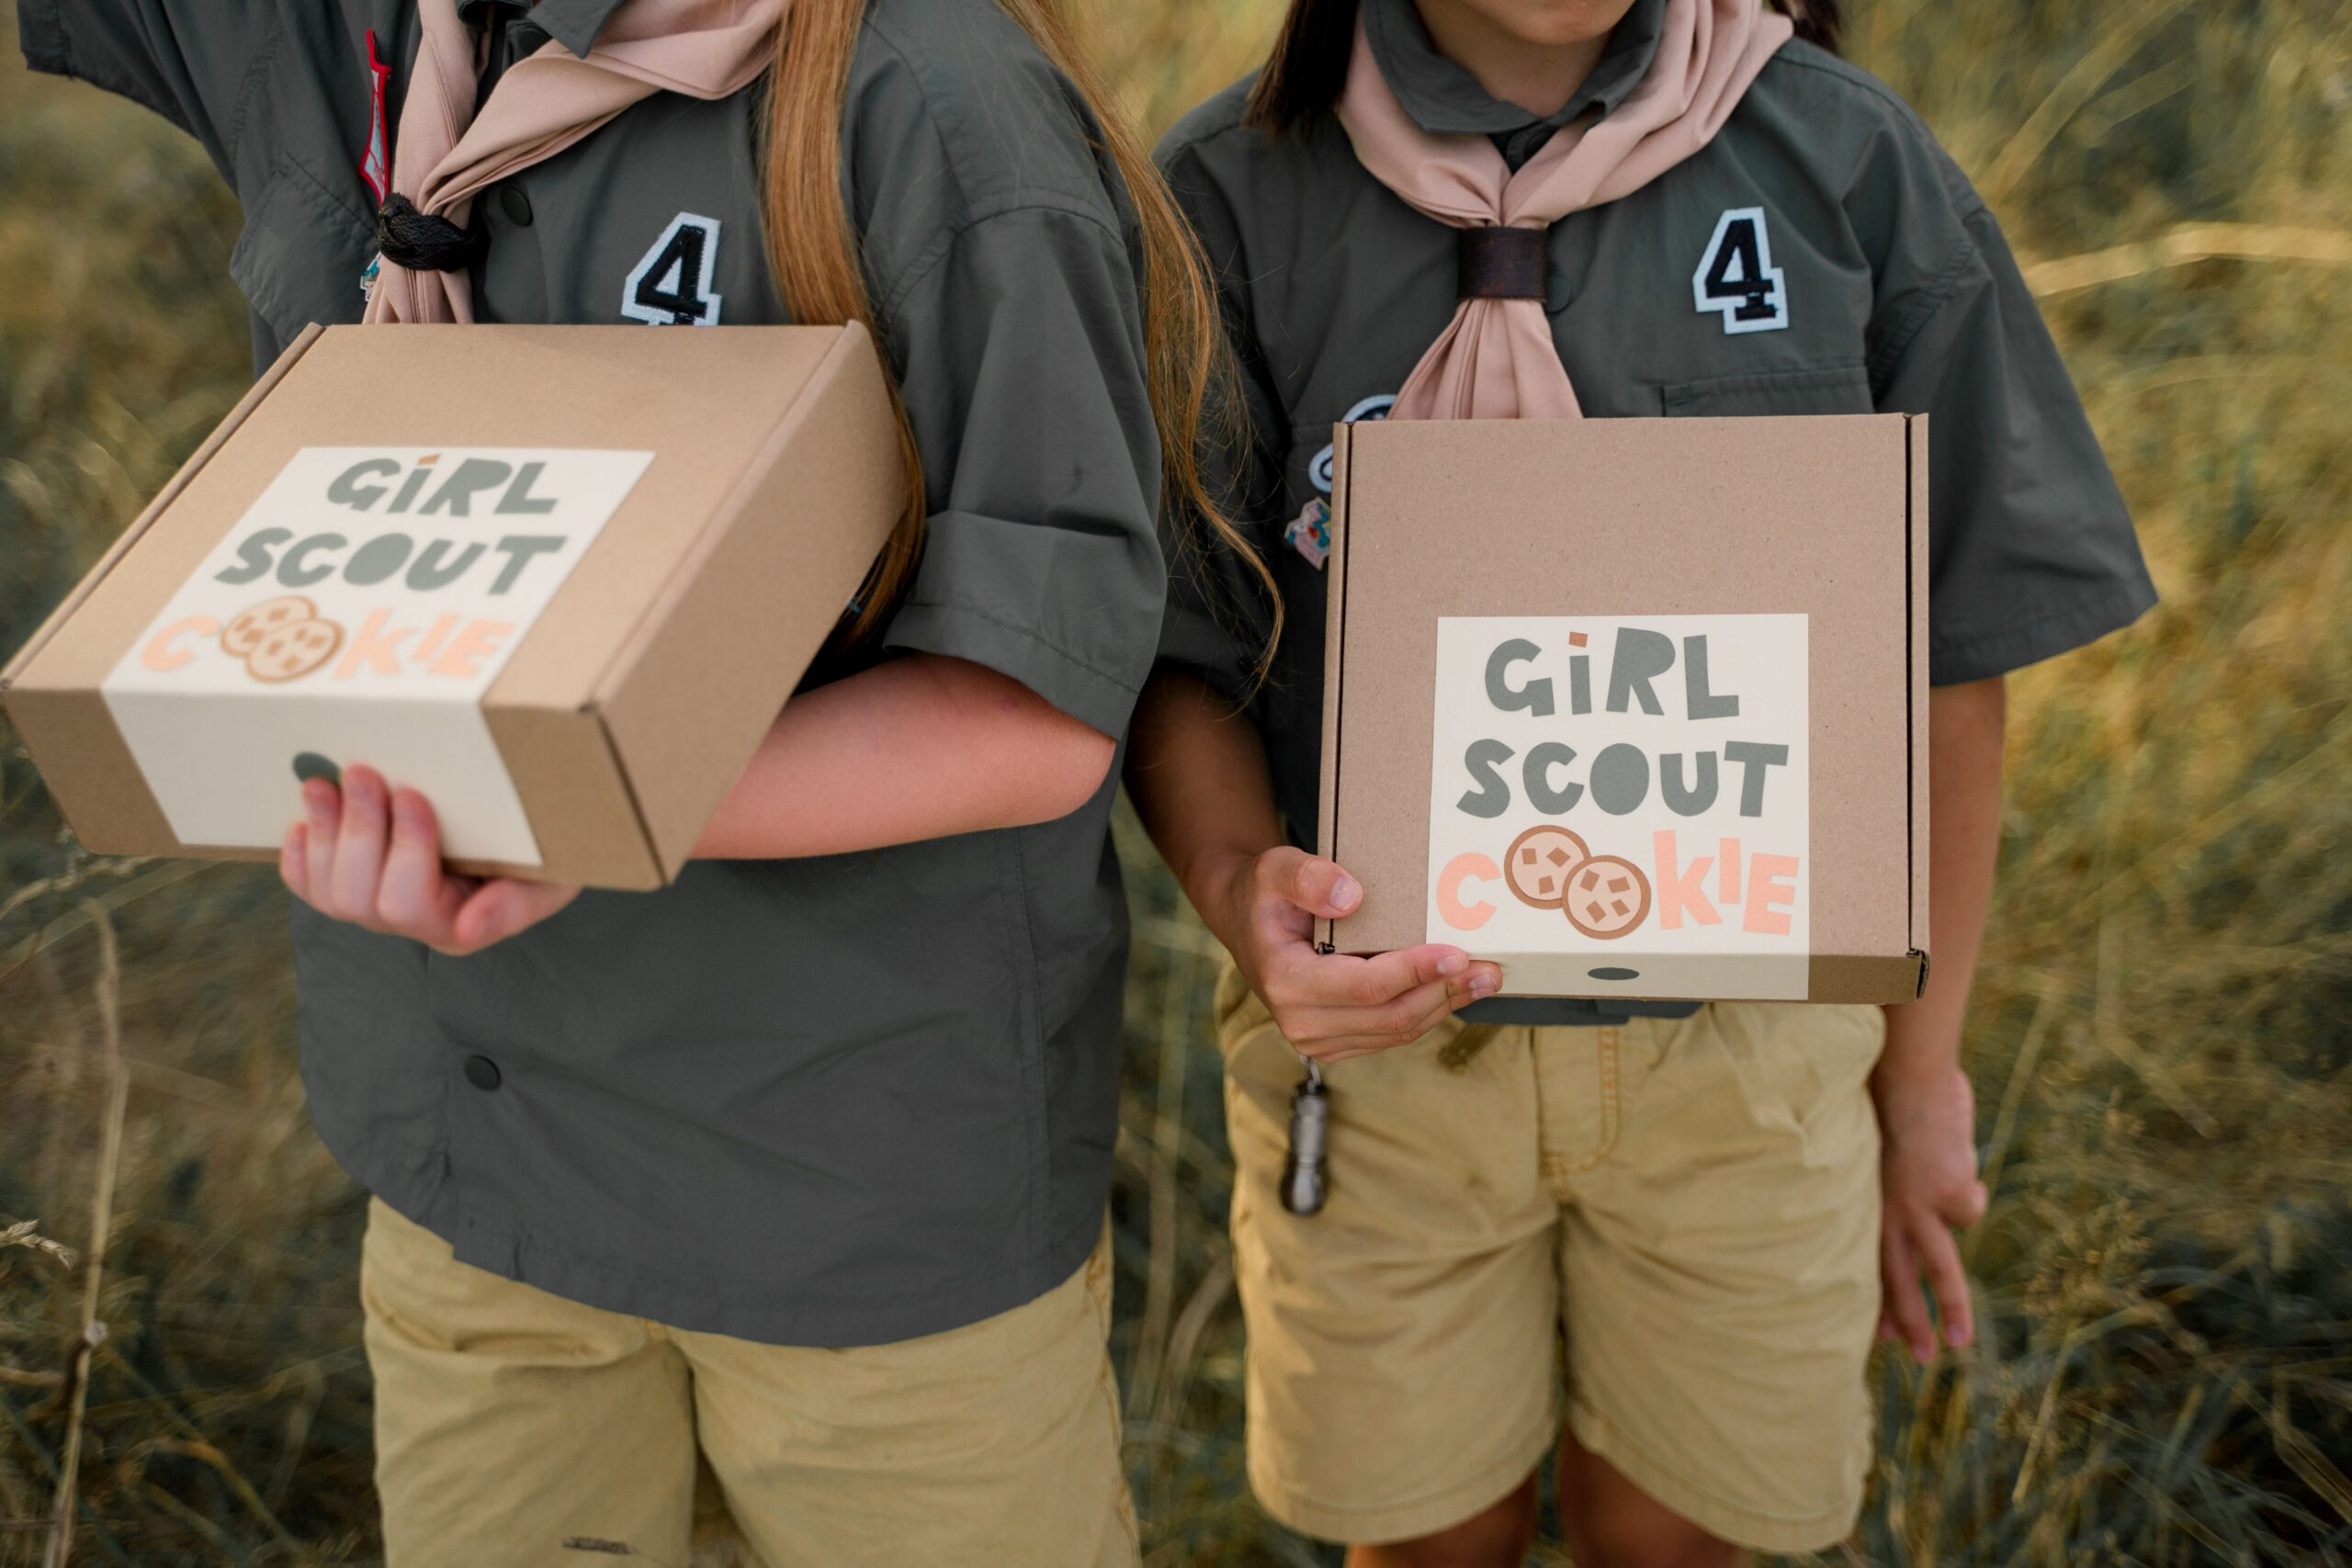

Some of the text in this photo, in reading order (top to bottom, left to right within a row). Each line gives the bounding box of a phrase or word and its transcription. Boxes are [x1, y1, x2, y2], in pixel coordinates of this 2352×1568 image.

[632, 220, 711, 324] 4
[1702, 214, 1781, 323] 4
[214, 527, 566, 595] SCOUT
[1455, 739, 1789, 818] SCOUT
